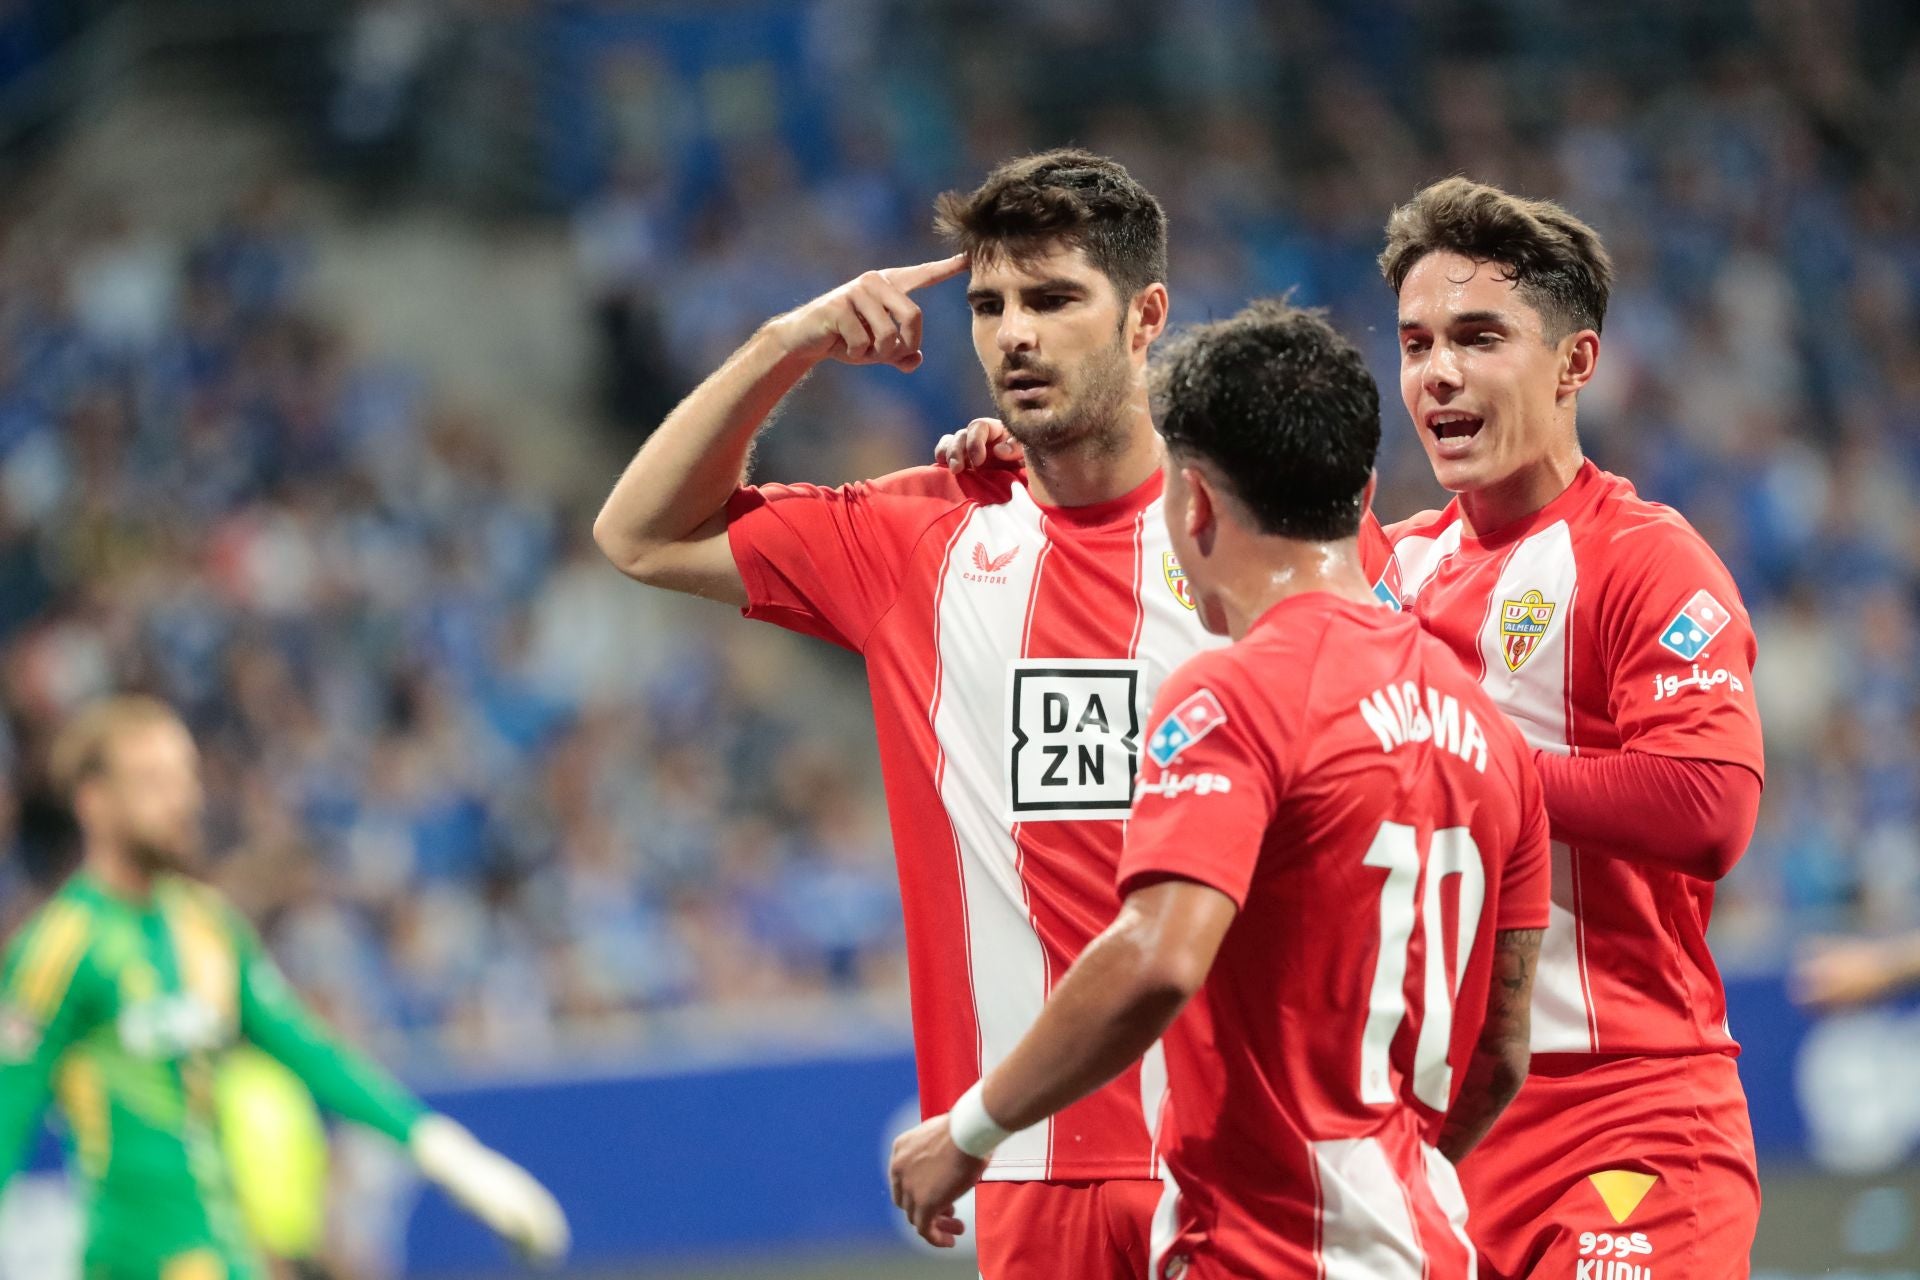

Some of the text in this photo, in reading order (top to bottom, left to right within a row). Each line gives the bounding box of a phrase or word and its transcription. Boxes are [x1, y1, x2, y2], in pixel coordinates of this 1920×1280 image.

[962, 572, 1008, 584] CASTORE
[1043, 692, 1110, 733] DA
[1040, 744, 1105, 786] ZN
[1362, 820, 1486, 1113] 10
